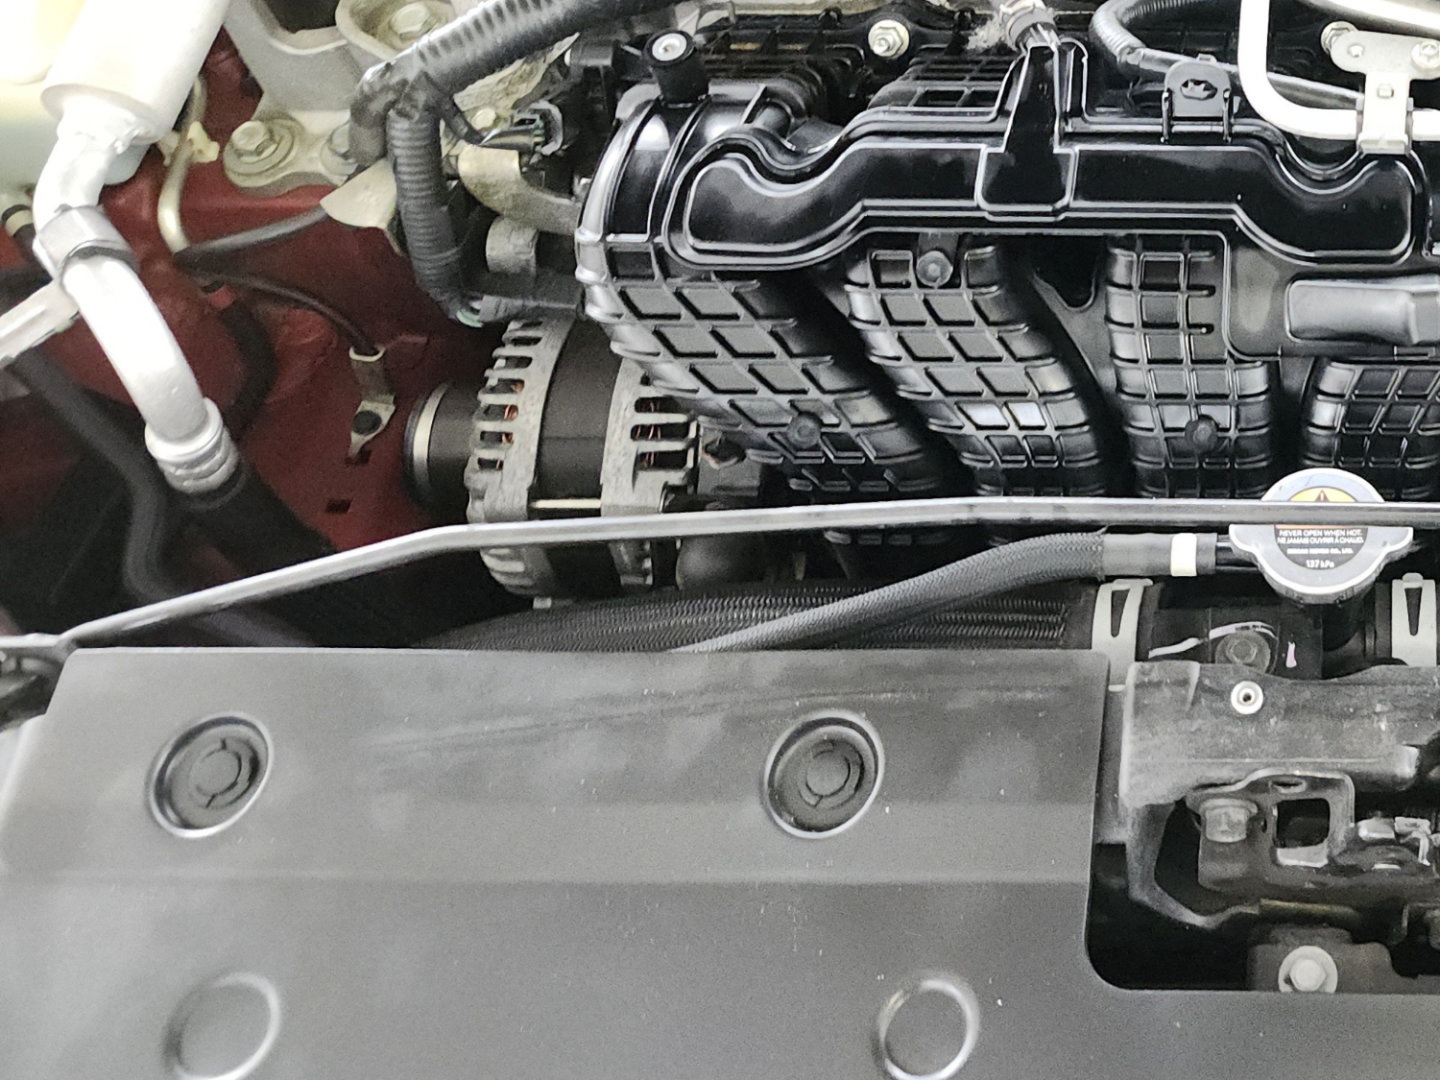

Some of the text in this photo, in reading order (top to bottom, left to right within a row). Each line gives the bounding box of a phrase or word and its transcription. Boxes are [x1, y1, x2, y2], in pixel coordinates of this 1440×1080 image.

[1279, 529, 1302, 537] NEVER
[1303, 529, 1323, 537] OPEN
[1324, 529, 1345, 537] WHEN
